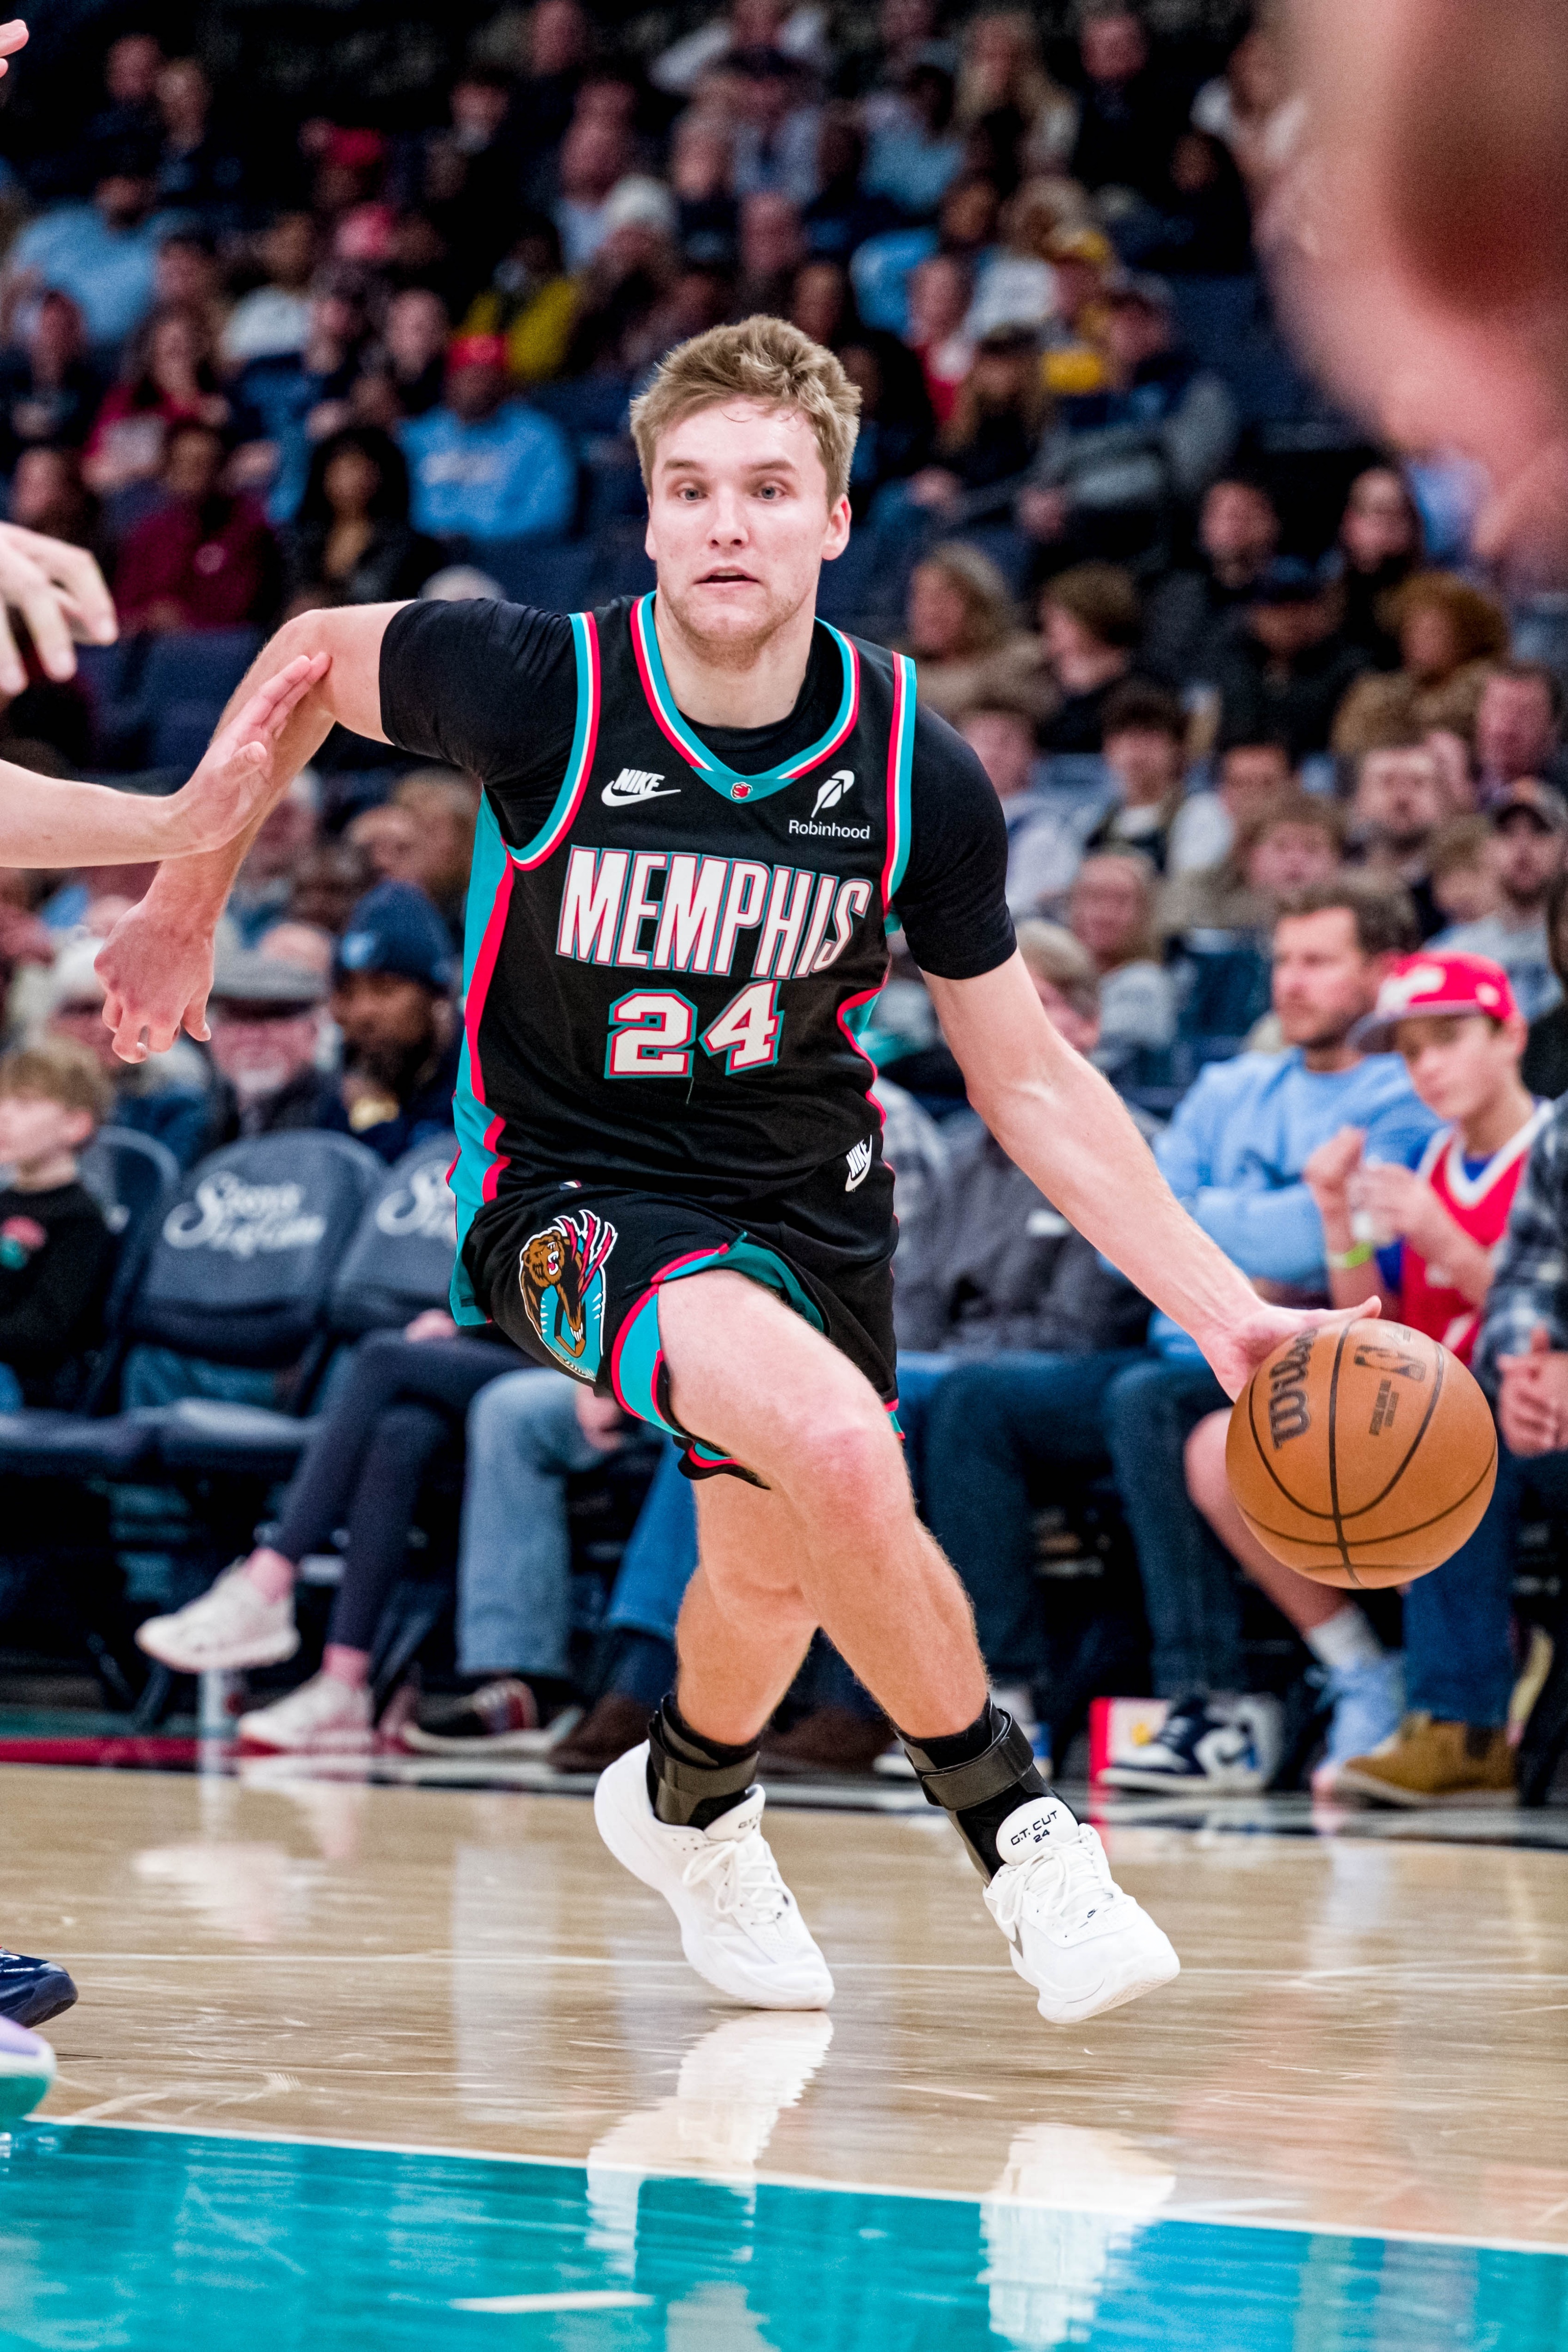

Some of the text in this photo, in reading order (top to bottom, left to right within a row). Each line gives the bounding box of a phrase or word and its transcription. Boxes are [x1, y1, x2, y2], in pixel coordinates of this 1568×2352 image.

[613, 768, 665, 794] NIKE
[788, 820, 870, 839] Robinhood
[556, 844, 874, 980] MEMPHIS
[604, 980, 785, 1080] 24
[846, 1139, 869, 1178] NIKE
[1033, 1810, 1057, 1831] CUT
[1033, 1829, 1050, 1843] 24
